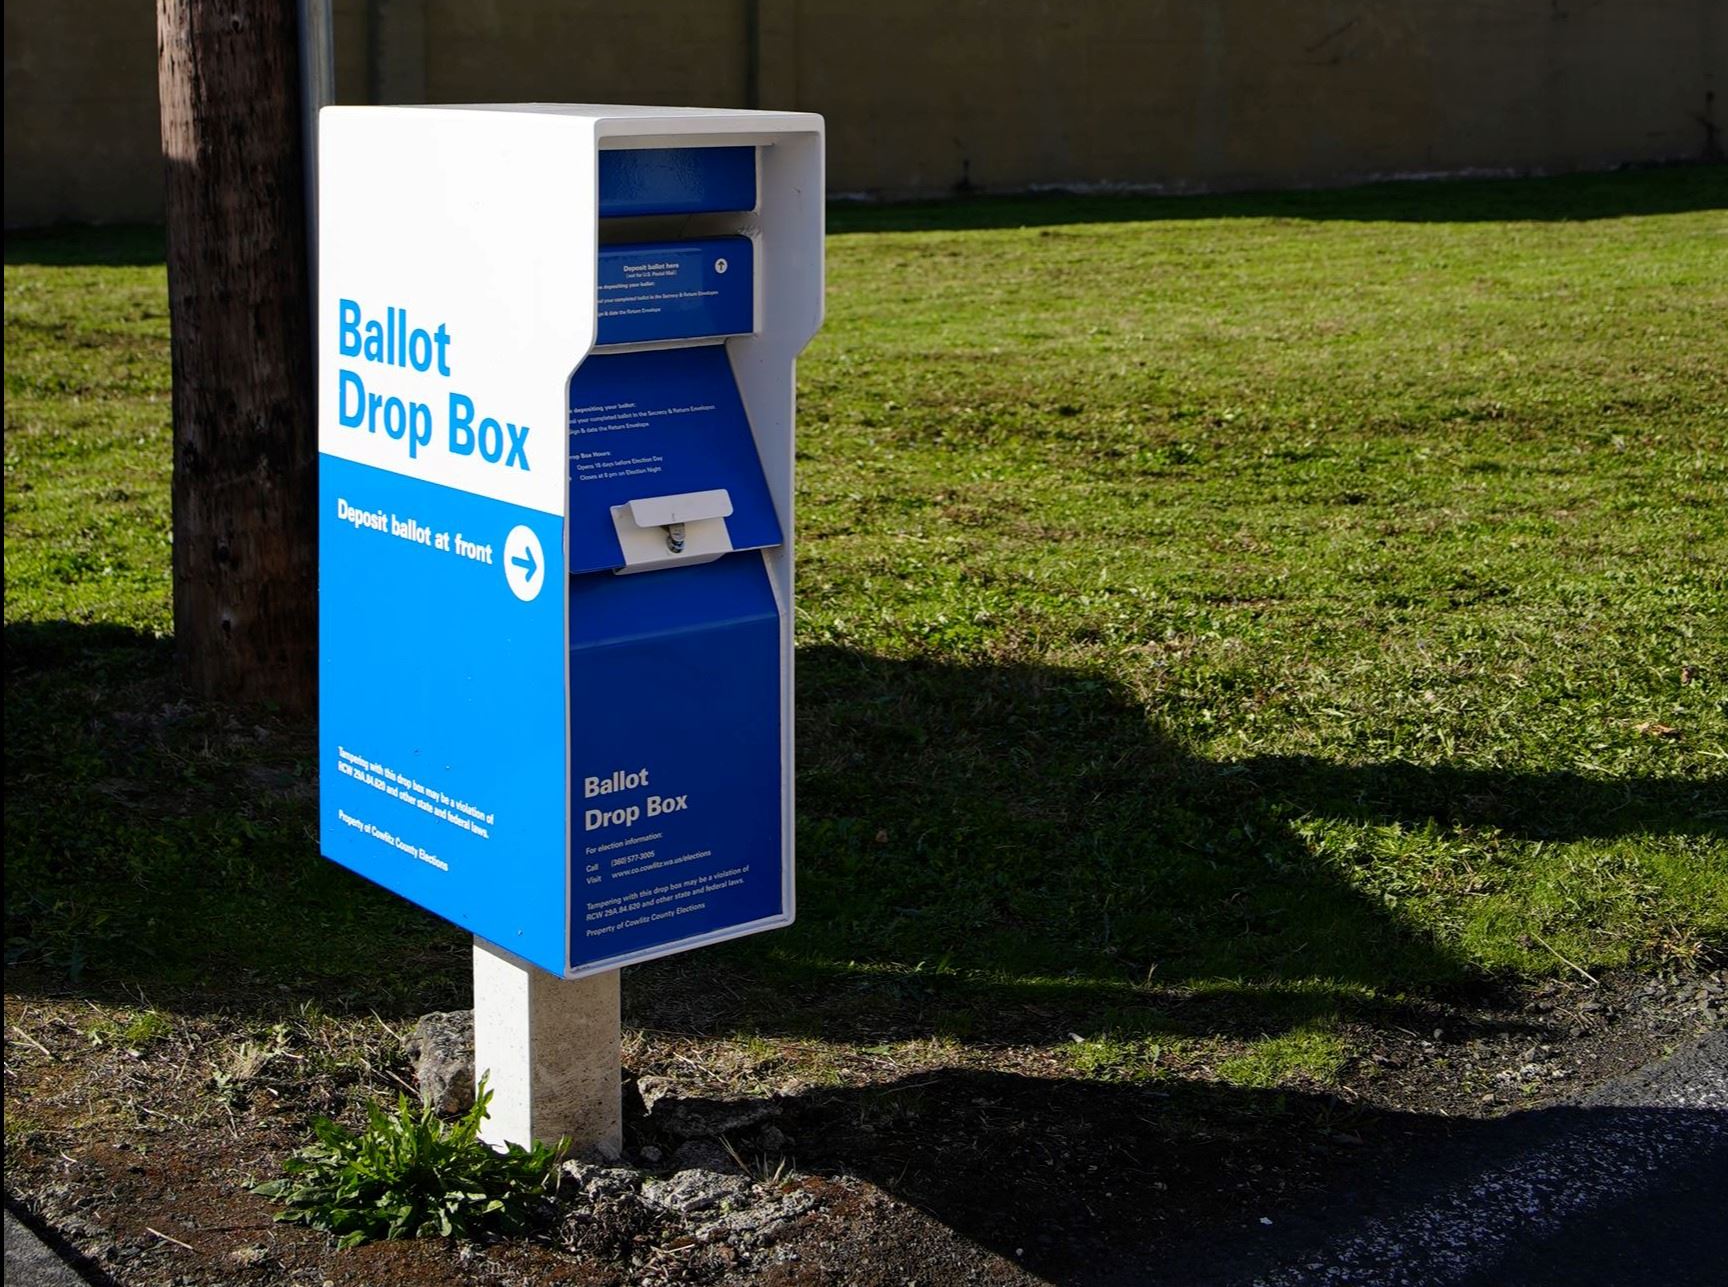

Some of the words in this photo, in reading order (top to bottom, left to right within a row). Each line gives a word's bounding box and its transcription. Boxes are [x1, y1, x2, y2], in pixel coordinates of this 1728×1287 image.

[623, 265, 647, 273] Deposit
[339, 298, 450, 377] Ballot
[339, 369, 432, 459] Drop
[449, 392, 530, 471] Box
[337, 497, 388, 533] Deposit
[391, 514, 431, 546] ballot
[435, 532, 450, 552] at
[455, 533, 493, 564] front
[584, 768, 648, 798] Ballot
[585, 806, 640, 831] Drop
[647, 795, 688, 817] Box
[586, 847, 597, 855] For
[598, 841, 624, 852] election
[586, 863, 599, 873] Call
[586, 875, 602, 884] Visit
[586, 897, 622, 910] Tampering
[622, 893, 639, 902] with
[639, 890, 652, 898] this
[653, 886, 669, 895] drop
[670, 881, 682, 890] box
[683, 879, 697, 888] may
[698, 876, 707, 884] be
[713, 868, 741, 880] violation
[742, 865, 749, 873] of
[586, 912, 603, 921] RCW
[642, 899, 655, 908] and
[655, 895, 674, 905] other
[674, 891, 691, 900] state
[692, 886, 705, 895] and
[705, 881, 727, 892] federal
[728, 878, 744, 886] laws.
[586, 925, 615, 937] Property
[616, 922, 624, 930] of
[625, 917, 650, 928] Cowlitz
[651, 910, 675, 921] County
[676, 902, 705, 915] Elections
